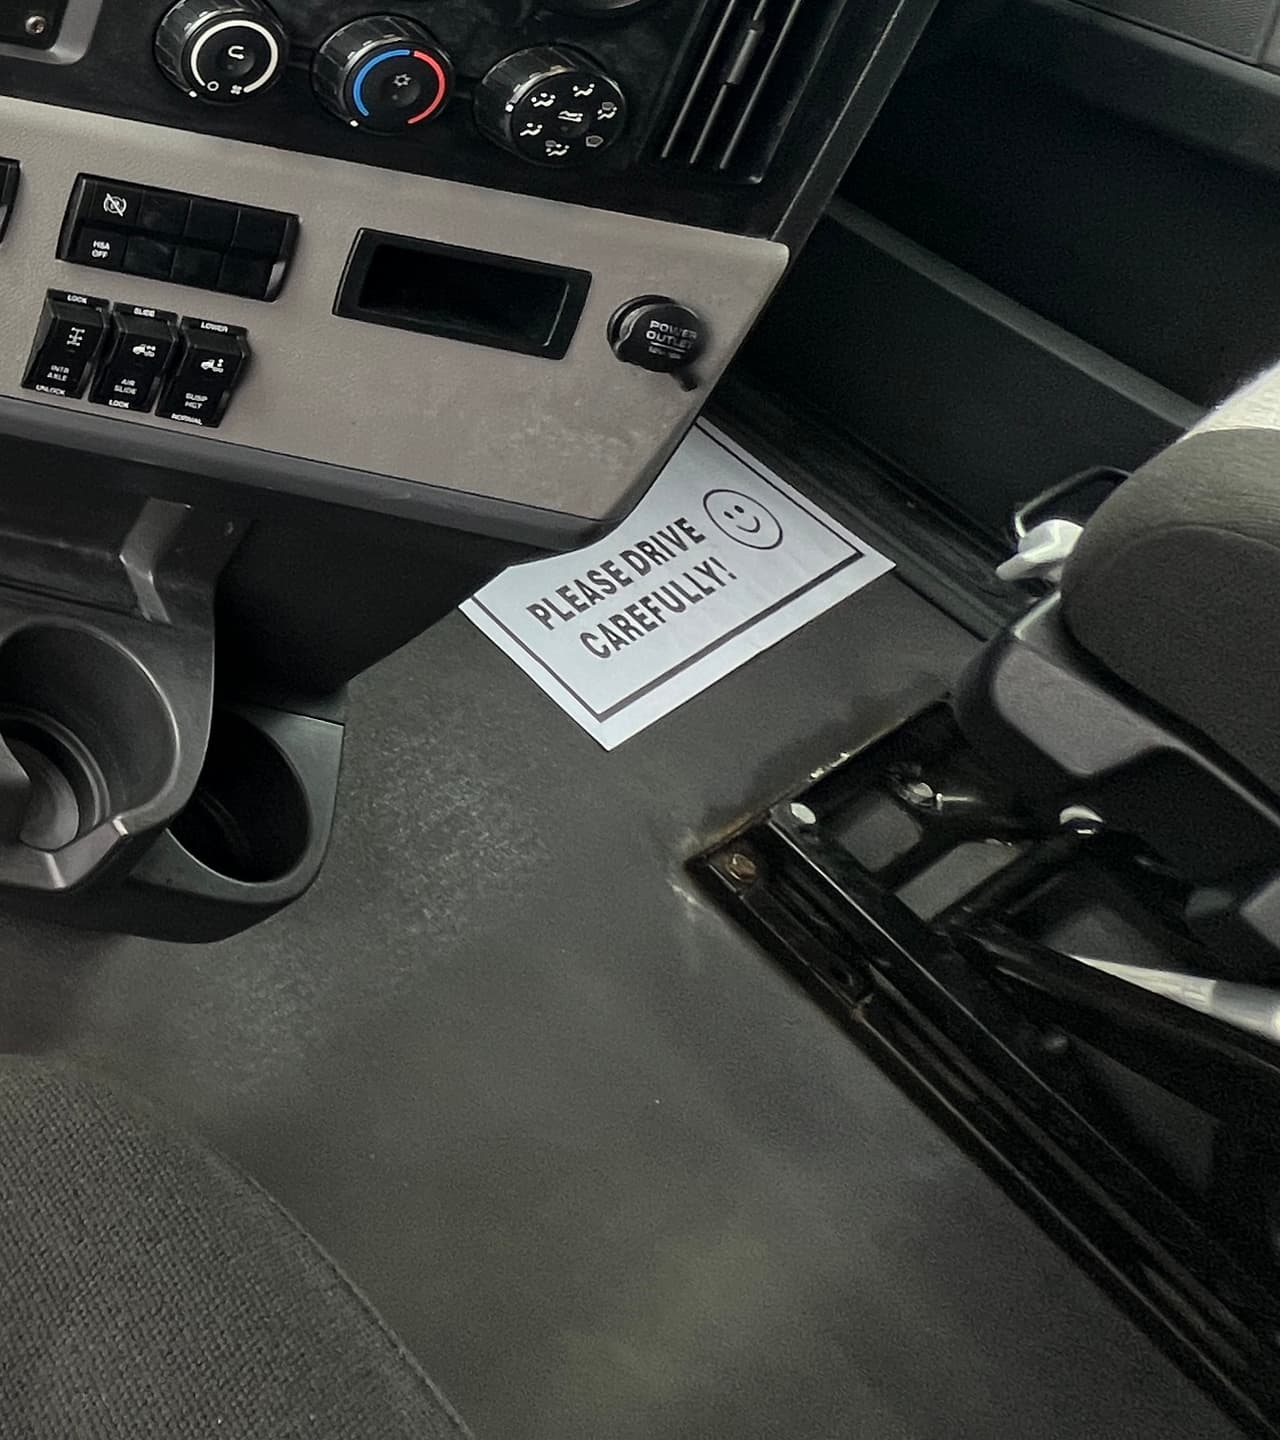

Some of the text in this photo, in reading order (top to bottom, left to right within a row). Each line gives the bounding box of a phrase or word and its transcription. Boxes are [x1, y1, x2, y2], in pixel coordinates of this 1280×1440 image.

[66, 294, 88, 304] LOCK
[200, 321, 229, 333] LOWER
[649, 320, 697, 339] POWER
[646, 330, 693, 350] OUTLET
[108, 398, 130, 409] LOCK
[525, 517, 707, 631] PLEASE DRIVE
[579, 555, 738, 659] CAREFULLY!
